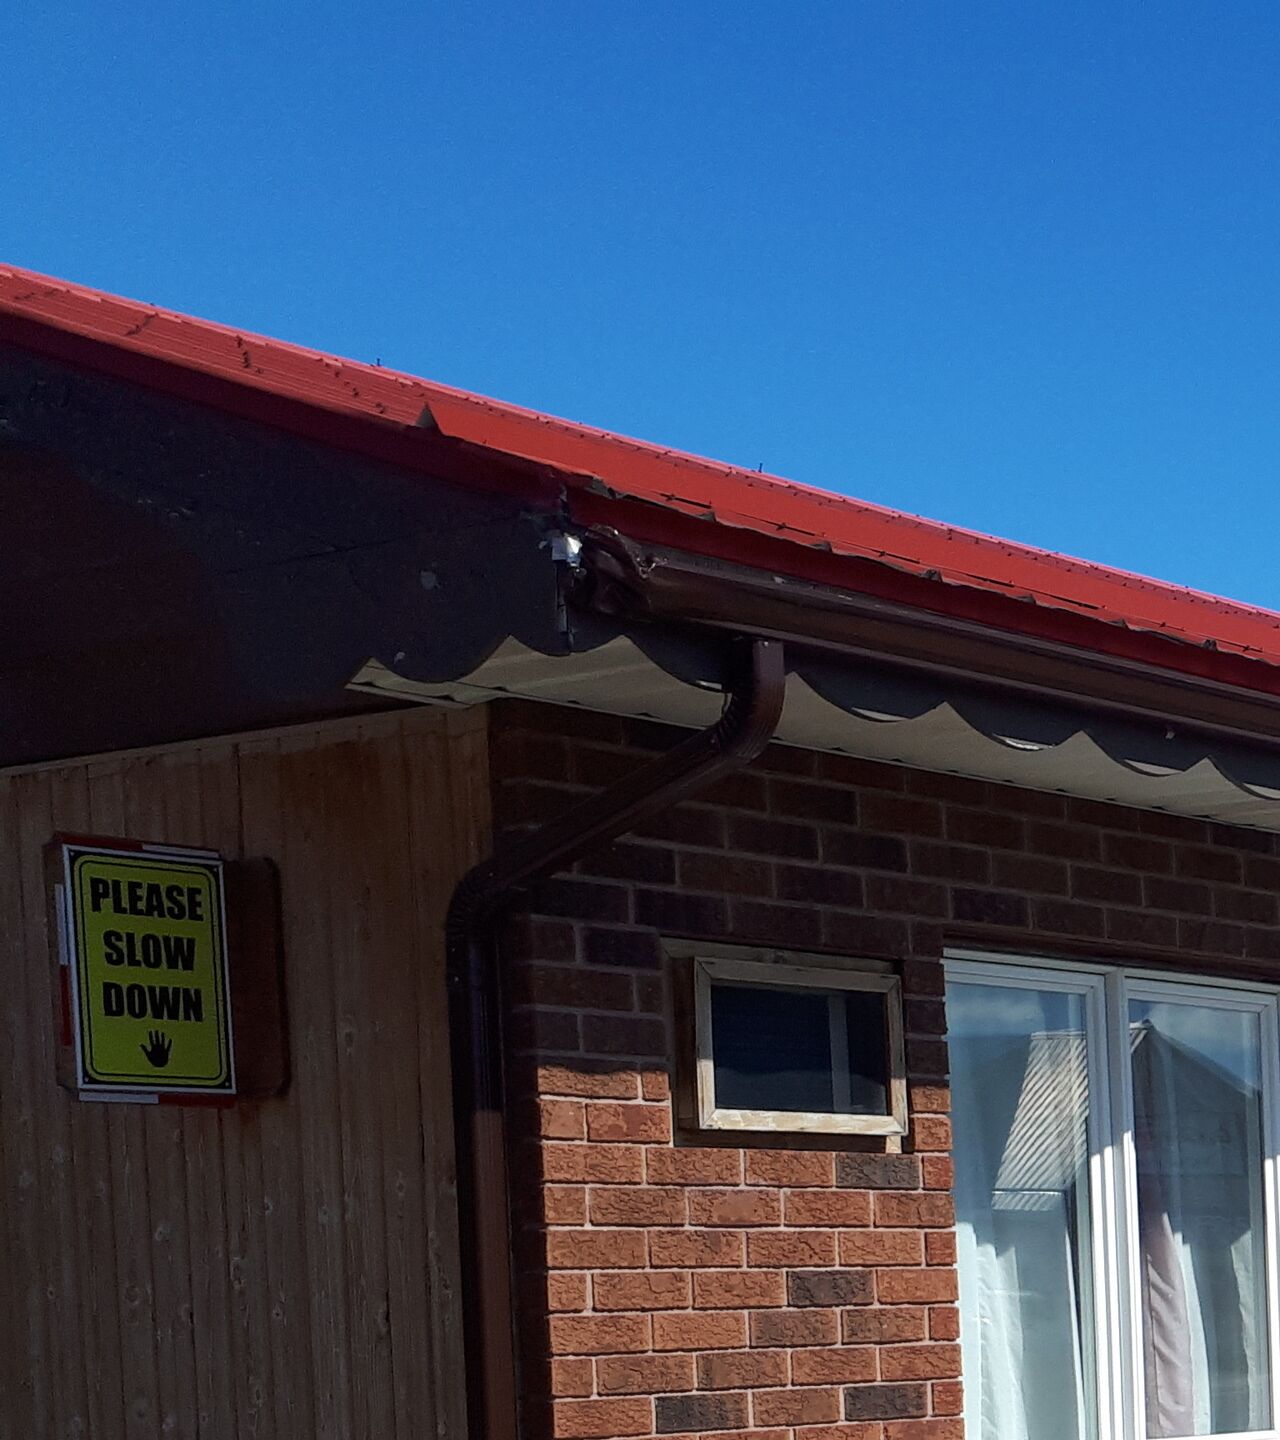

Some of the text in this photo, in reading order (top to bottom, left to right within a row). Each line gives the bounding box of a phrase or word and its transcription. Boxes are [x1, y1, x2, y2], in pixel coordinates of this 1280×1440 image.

[90, 877, 203, 921] PLEASE
[102, 930, 196, 970] SLOW
[102, 982, 203, 1022] DOWN
